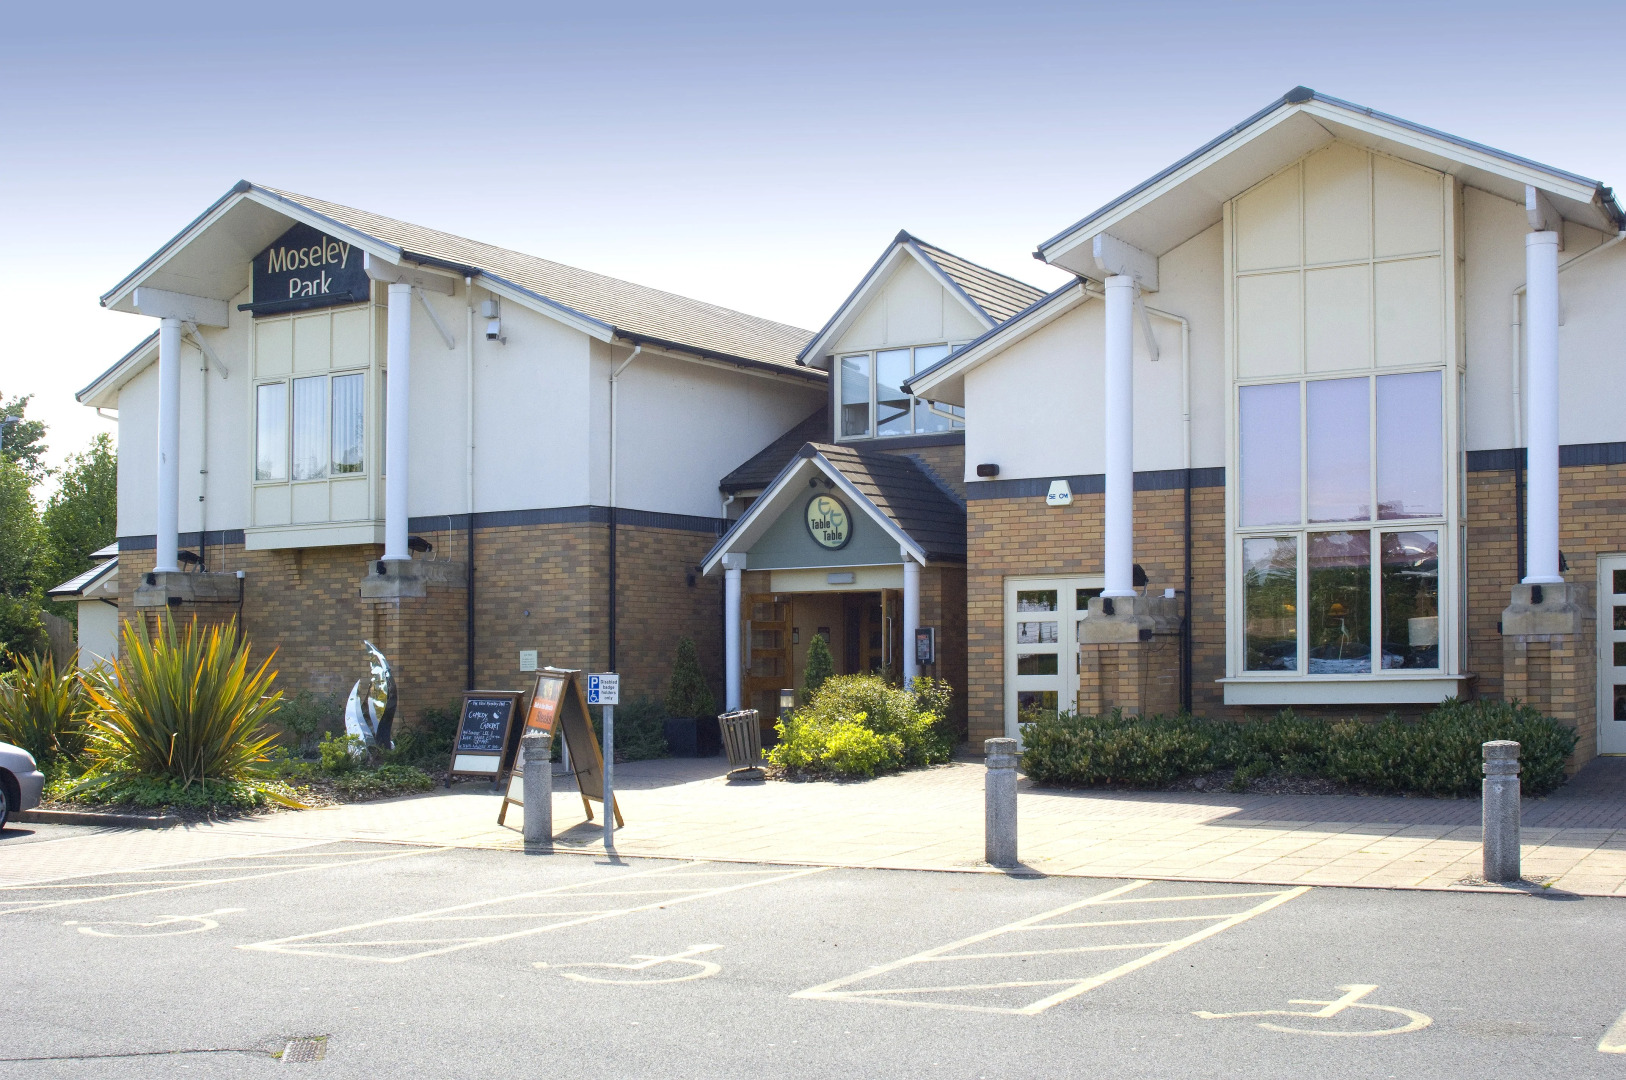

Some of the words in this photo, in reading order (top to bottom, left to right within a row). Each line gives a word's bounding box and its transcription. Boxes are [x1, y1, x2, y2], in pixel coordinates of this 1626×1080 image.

[268, 236, 351, 274] Moseley
[289, 270, 332, 299] Park
[811, 516, 831, 530] Table
[823, 528, 843, 541] Table
[591, 677, 599, 689] P
